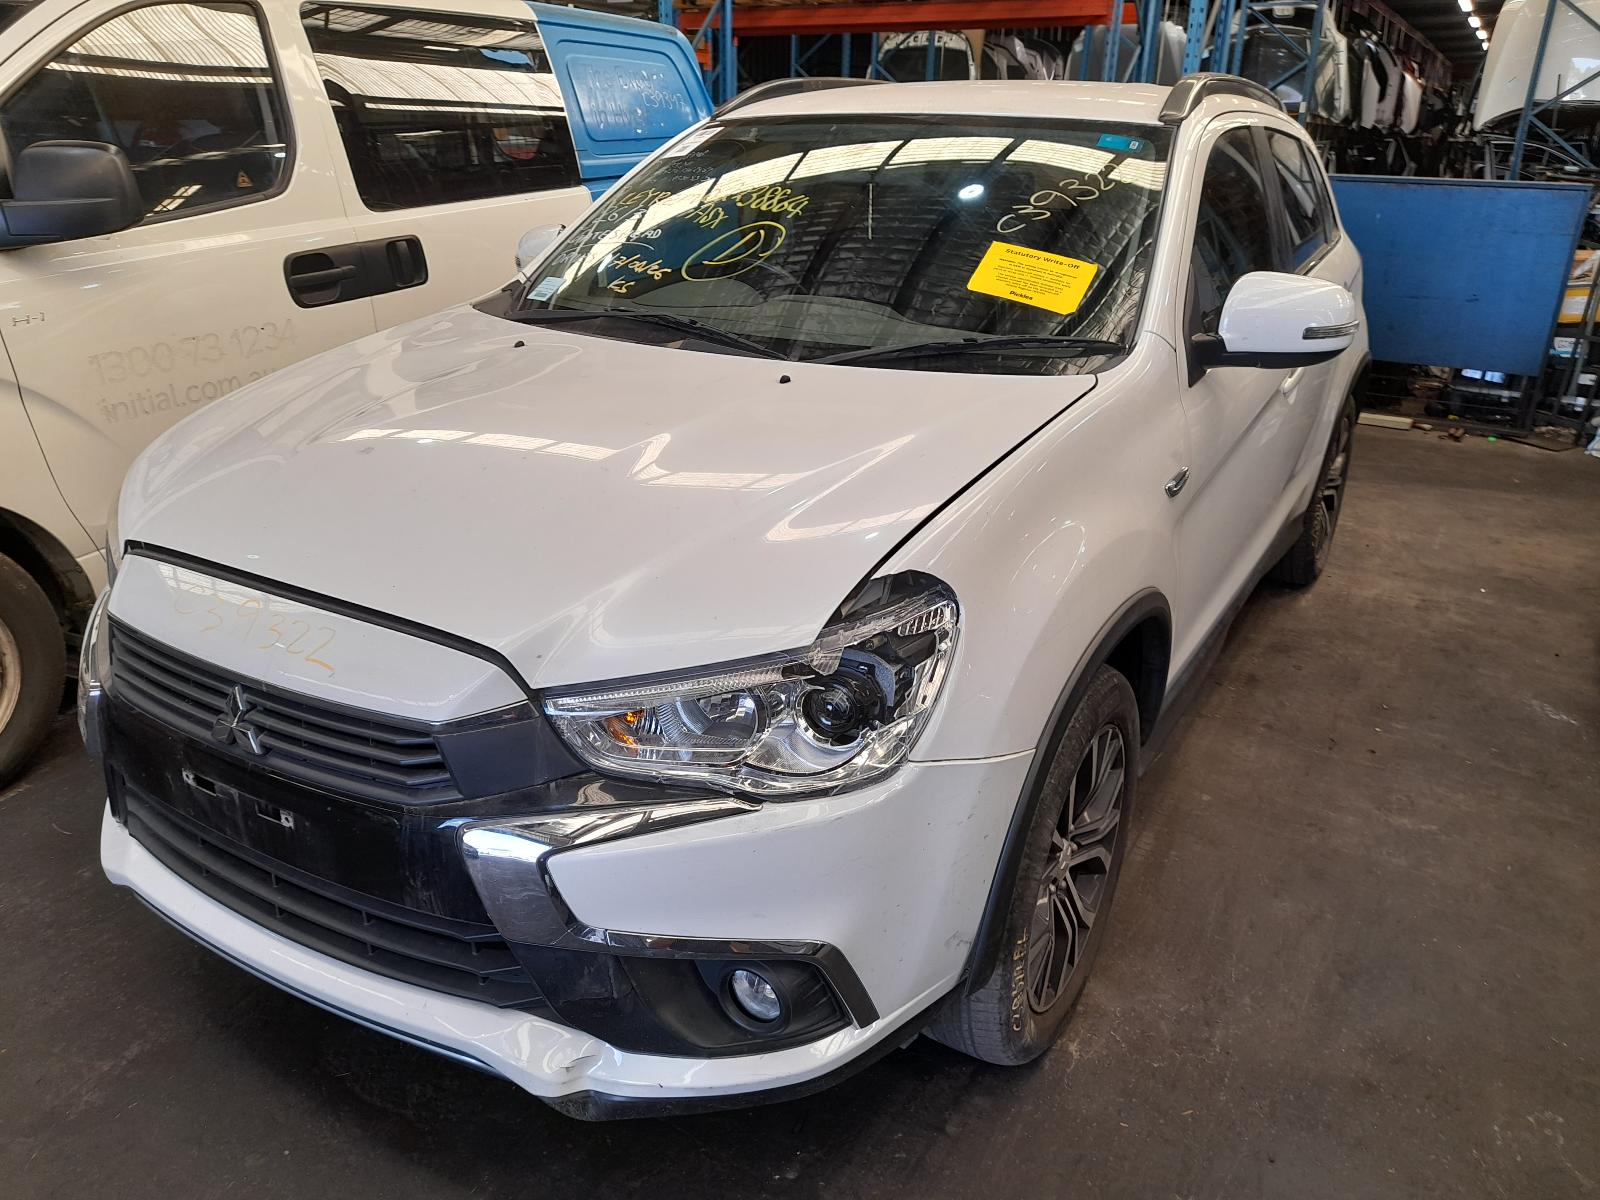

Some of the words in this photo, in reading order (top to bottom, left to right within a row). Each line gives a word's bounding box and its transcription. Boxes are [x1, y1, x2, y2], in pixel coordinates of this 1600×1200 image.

[1005, 248, 1042, 261] Statutory
[1043, 257, 1081, 270] Write-Off
[88, 343, 175, 385] 1300
[178, 332, 227, 366] 73
